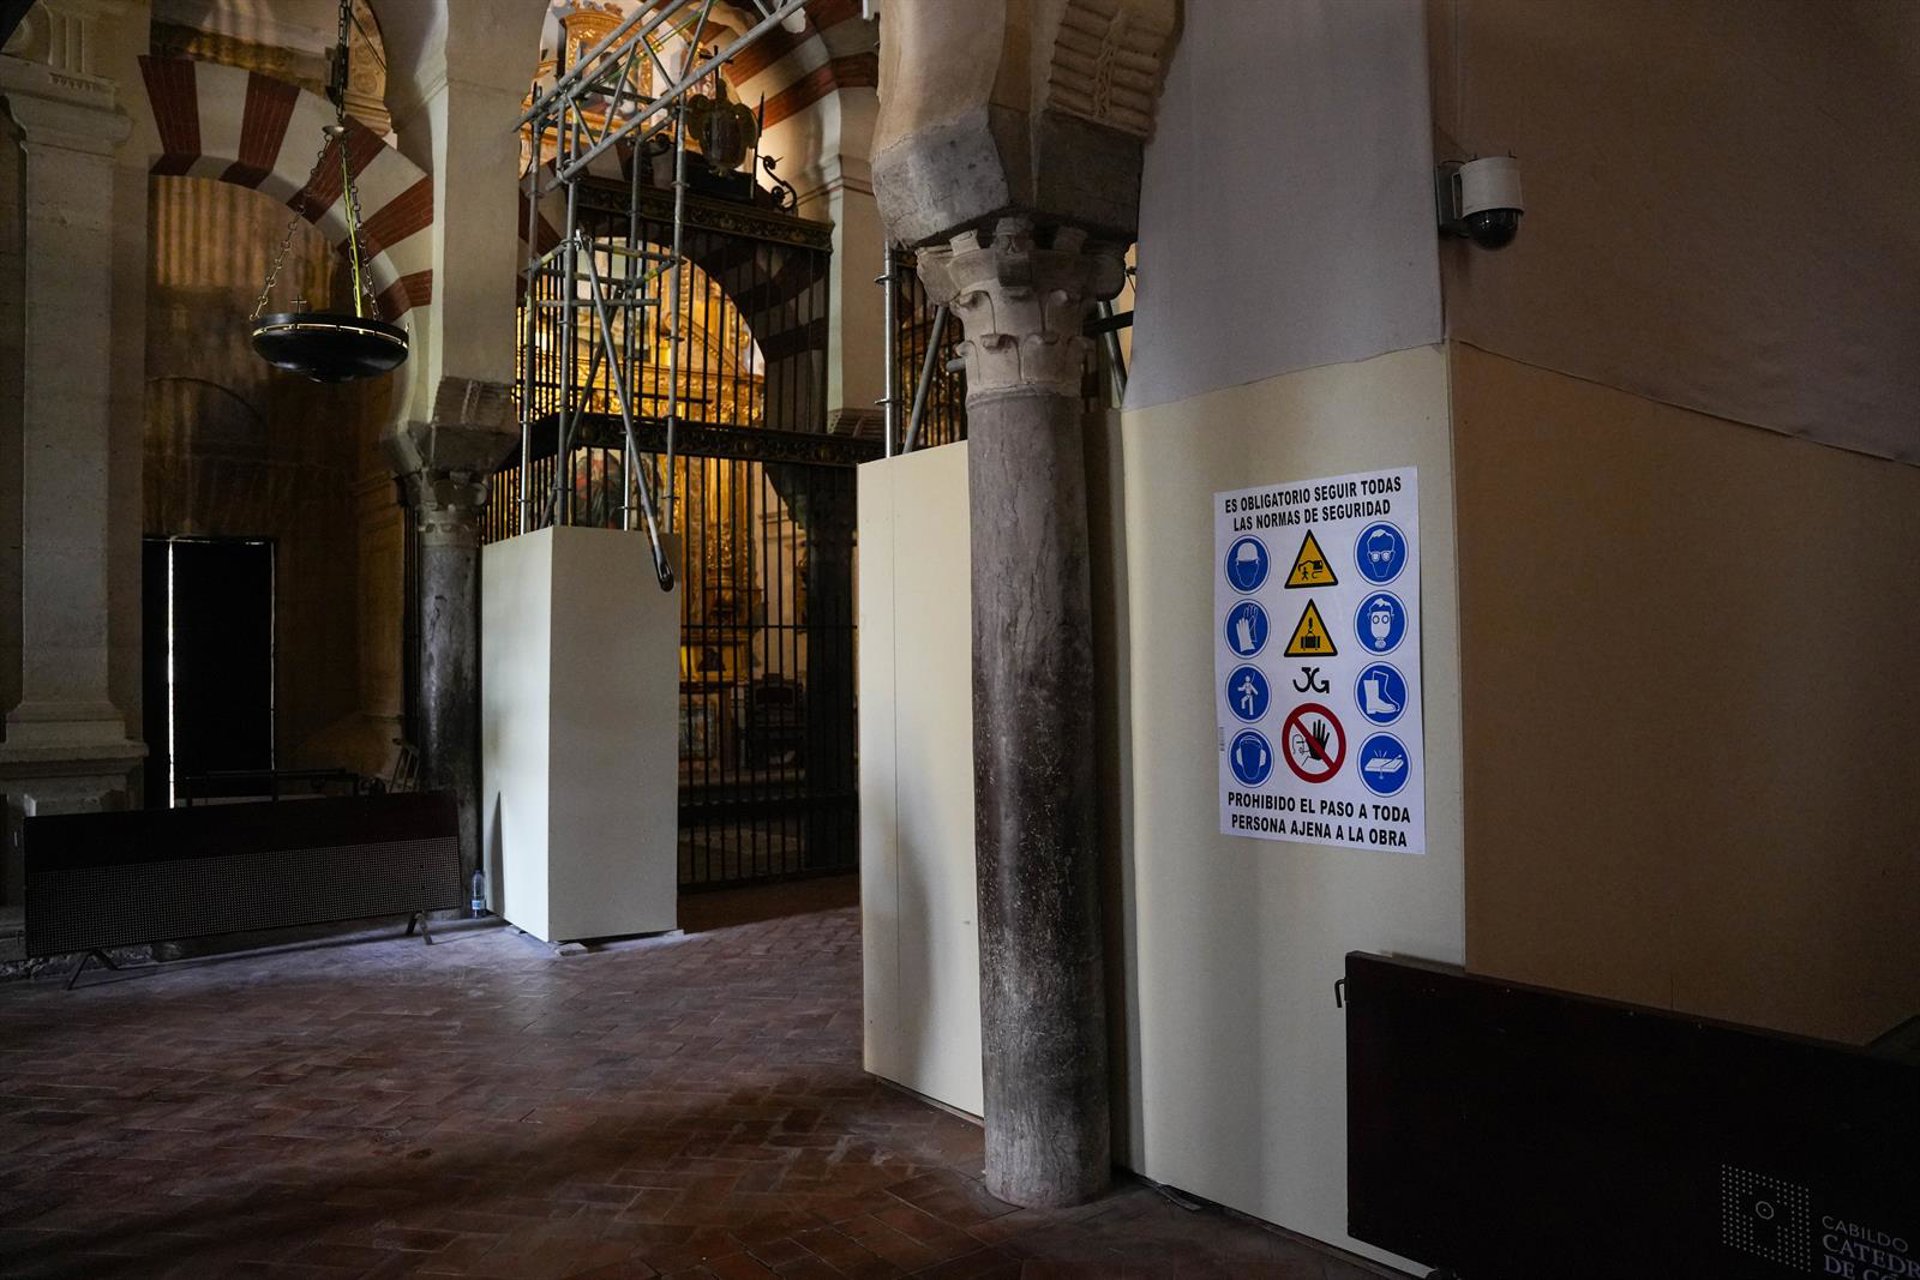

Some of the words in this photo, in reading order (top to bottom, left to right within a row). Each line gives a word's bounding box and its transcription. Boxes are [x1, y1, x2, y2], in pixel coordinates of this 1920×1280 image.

[1225, 499, 1237, 513] ES
[1240, 489, 1310, 511] OBLIGATORIO
[1314, 481, 1357, 502] SEGUIR
[1360, 476, 1402, 495] TODAS
[1233, 516, 1253, 532] LAS
[1256, 509, 1301, 528] NORMAS
[1304, 507, 1319, 523] DE
[1322, 499, 1391, 522] SEGURIDAD
[1228, 791, 1296, 811] PROHIBIDO
[1300, 798, 1315, 814] EL
[1320, 799, 1354, 817] PASO
[1358, 803, 1367, 819] A
[1372, 804, 1411, 823] TODA
[1231, 814, 1286, 834] PERSONA
[1290, 820, 1331, 839] AJENA
[1335, 825, 1344, 840] A
[1348, 826, 1364, 843] LA
[1369, 829, 1407, 847] OBRA
[1822, 1215, 1909, 1253] CABILDO
[1824, 1254, 1855, 1280] DE
